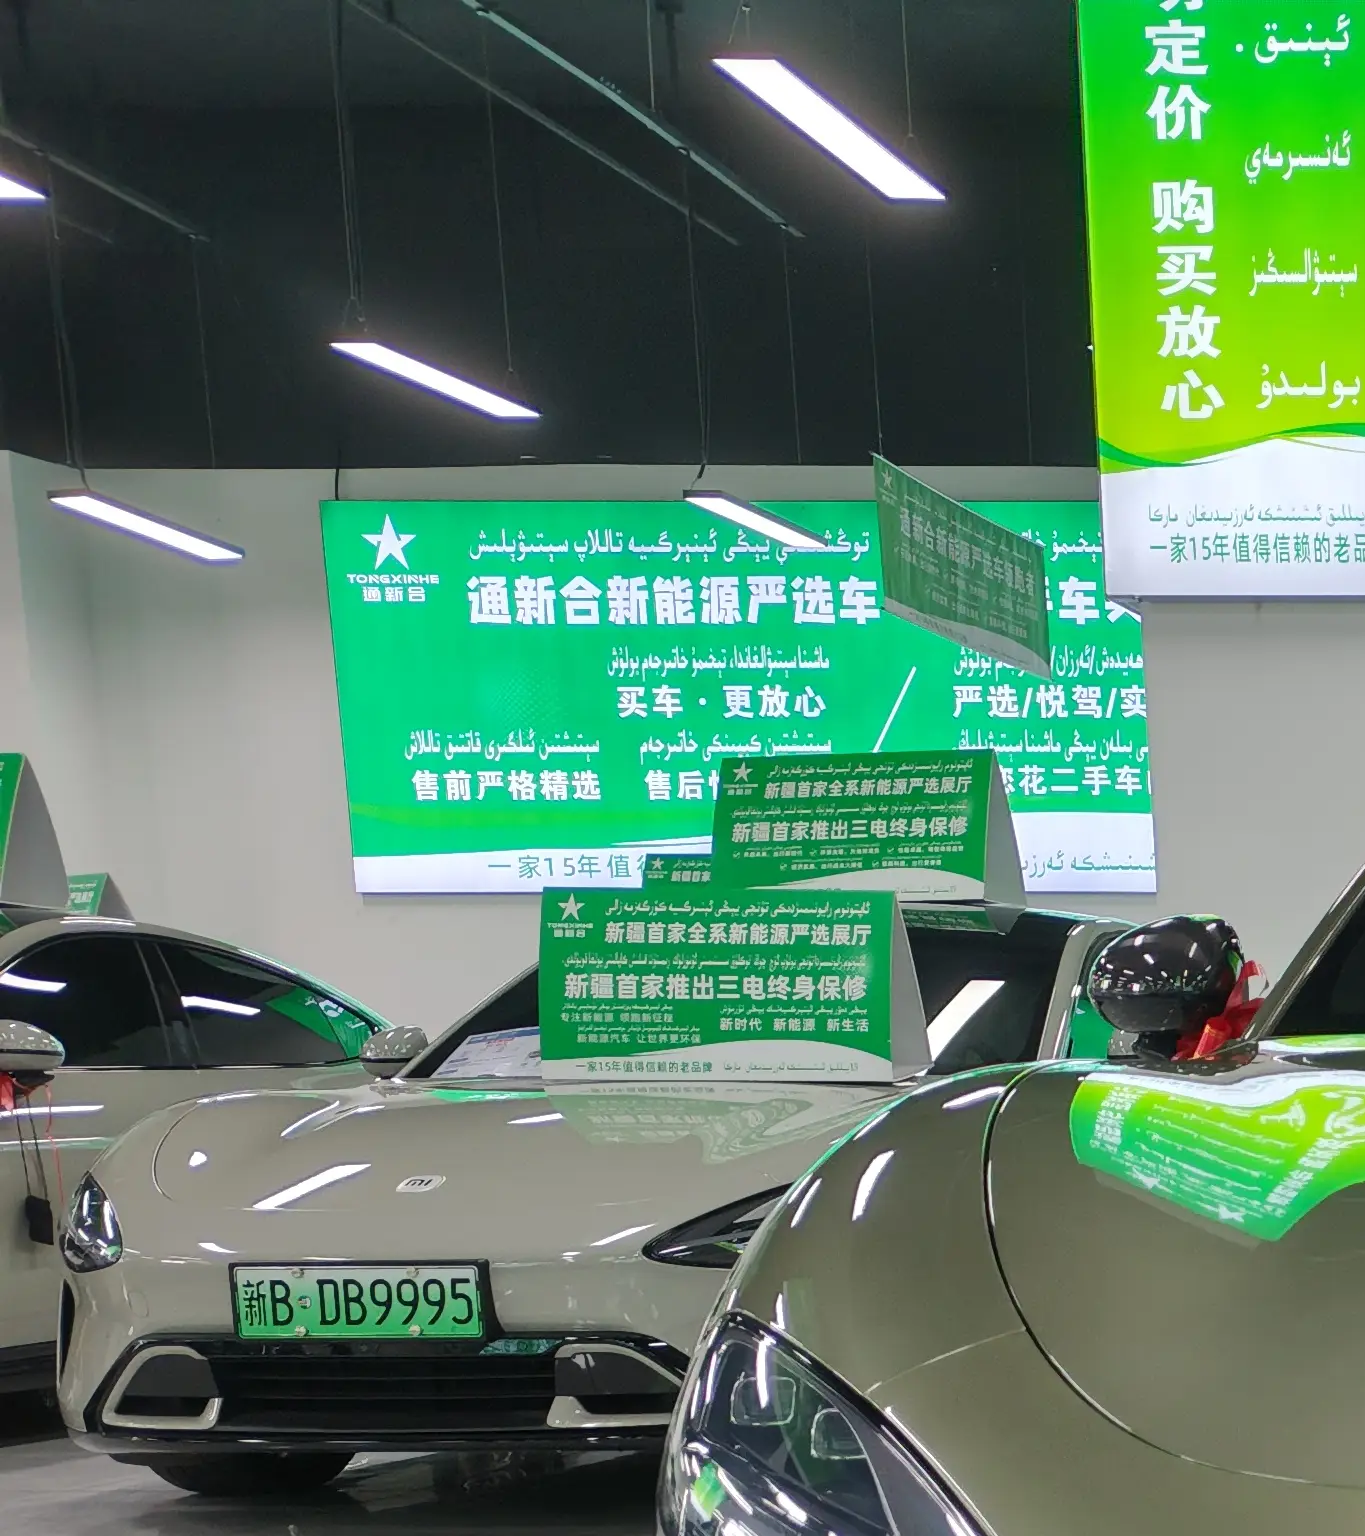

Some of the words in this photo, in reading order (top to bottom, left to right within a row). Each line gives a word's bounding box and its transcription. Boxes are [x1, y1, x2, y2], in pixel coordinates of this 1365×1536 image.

[1152, 179, 1225, 420] 购买放心
[347, 573, 440, 585] TONGXINHE
[362, 586, 426, 602] 通新合
[466, 574, 881, 625] 通新合新能源严选车
[410, 769, 602, 801] 售前严格精选
[764, 776, 972, 800] 新疆首家全系新能源严选展厅
[1000, 764, 1152, 797] 花二手车
[731, 815, 969, 844] 新疆首家推出三电终身保修
[604, 921, 871, 946] 新疆首家全系新能源严选展厅
[563, 973, 868, 1001] 新疆首家推出三电终身保修
[719, 1017, 762, 1032] 新时代
[773, 1017, 816, 1032] 新能源
[827, 1017, 869, 1032] 新生活
[575, 1060, 713, 1073] 一家15年值得信赖的老品牌
